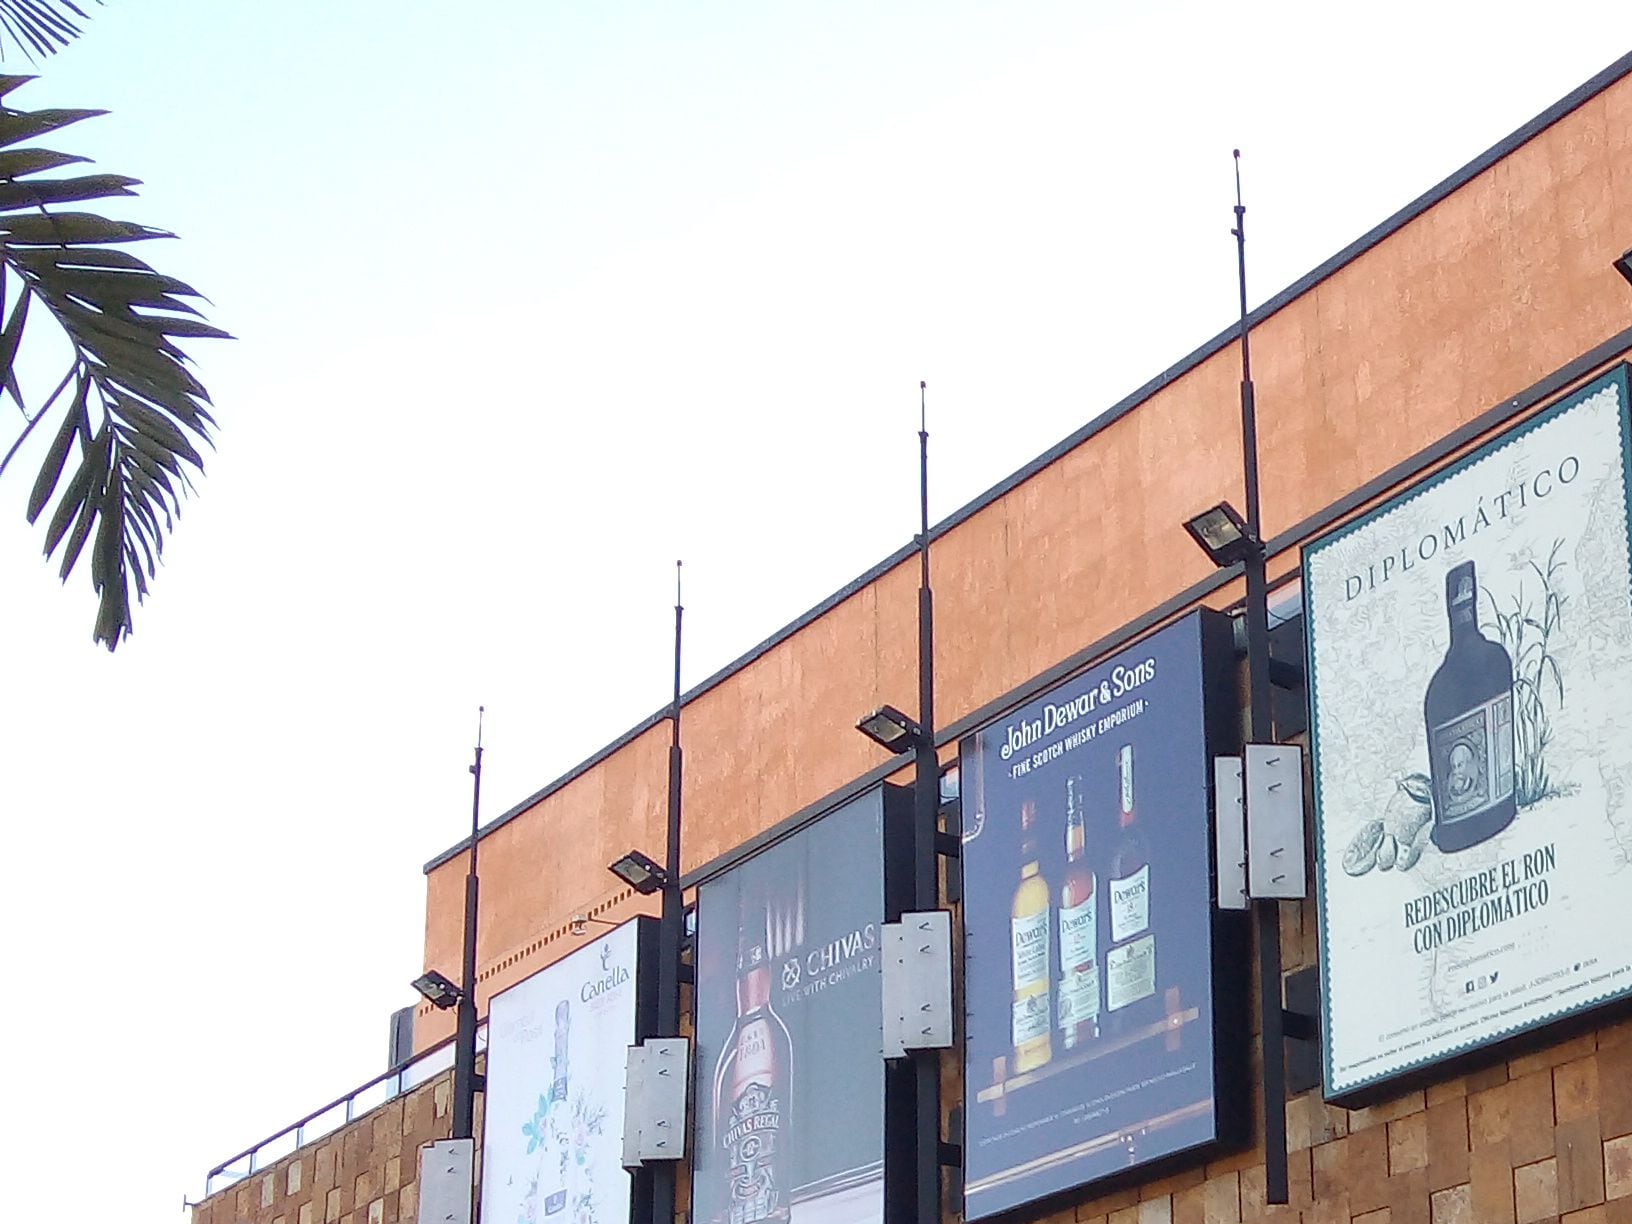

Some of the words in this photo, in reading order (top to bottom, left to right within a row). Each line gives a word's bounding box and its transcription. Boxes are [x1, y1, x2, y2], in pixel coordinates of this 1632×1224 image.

[1345, 455, 1580, 602] DIPLOMÁTICO
[1000, 718, 1043, 760] John
[1043, 687, 1099, 735] Dewar
[1099, 680, 1113, 704] &
[1111, 657, 1156, 698] Sons
[1012, 758, 1032, 780] FINE
[1032, 740, 1064, 769] SCOTCH
[1064, 723, 1097, 752] WHISKY
[1098, 698, 1144, 735] EMPORIUM
[1404, 867, 1499, 929] REDESCUBRE
[1501, 859, 1521, 889] EL
[1522, 842, 1557, 882] RON
[1413, 919, 1444, 955] CON
[1446, 878, 1549, 943] DIPLOMÁTICO
[580, 965, 631, 1003] Canella
[806, 923, 875, 977] CHIVAS
[723, 1118, 753, 1149] CHIVAS
[753, 1113, 780, 1132] REGAL
